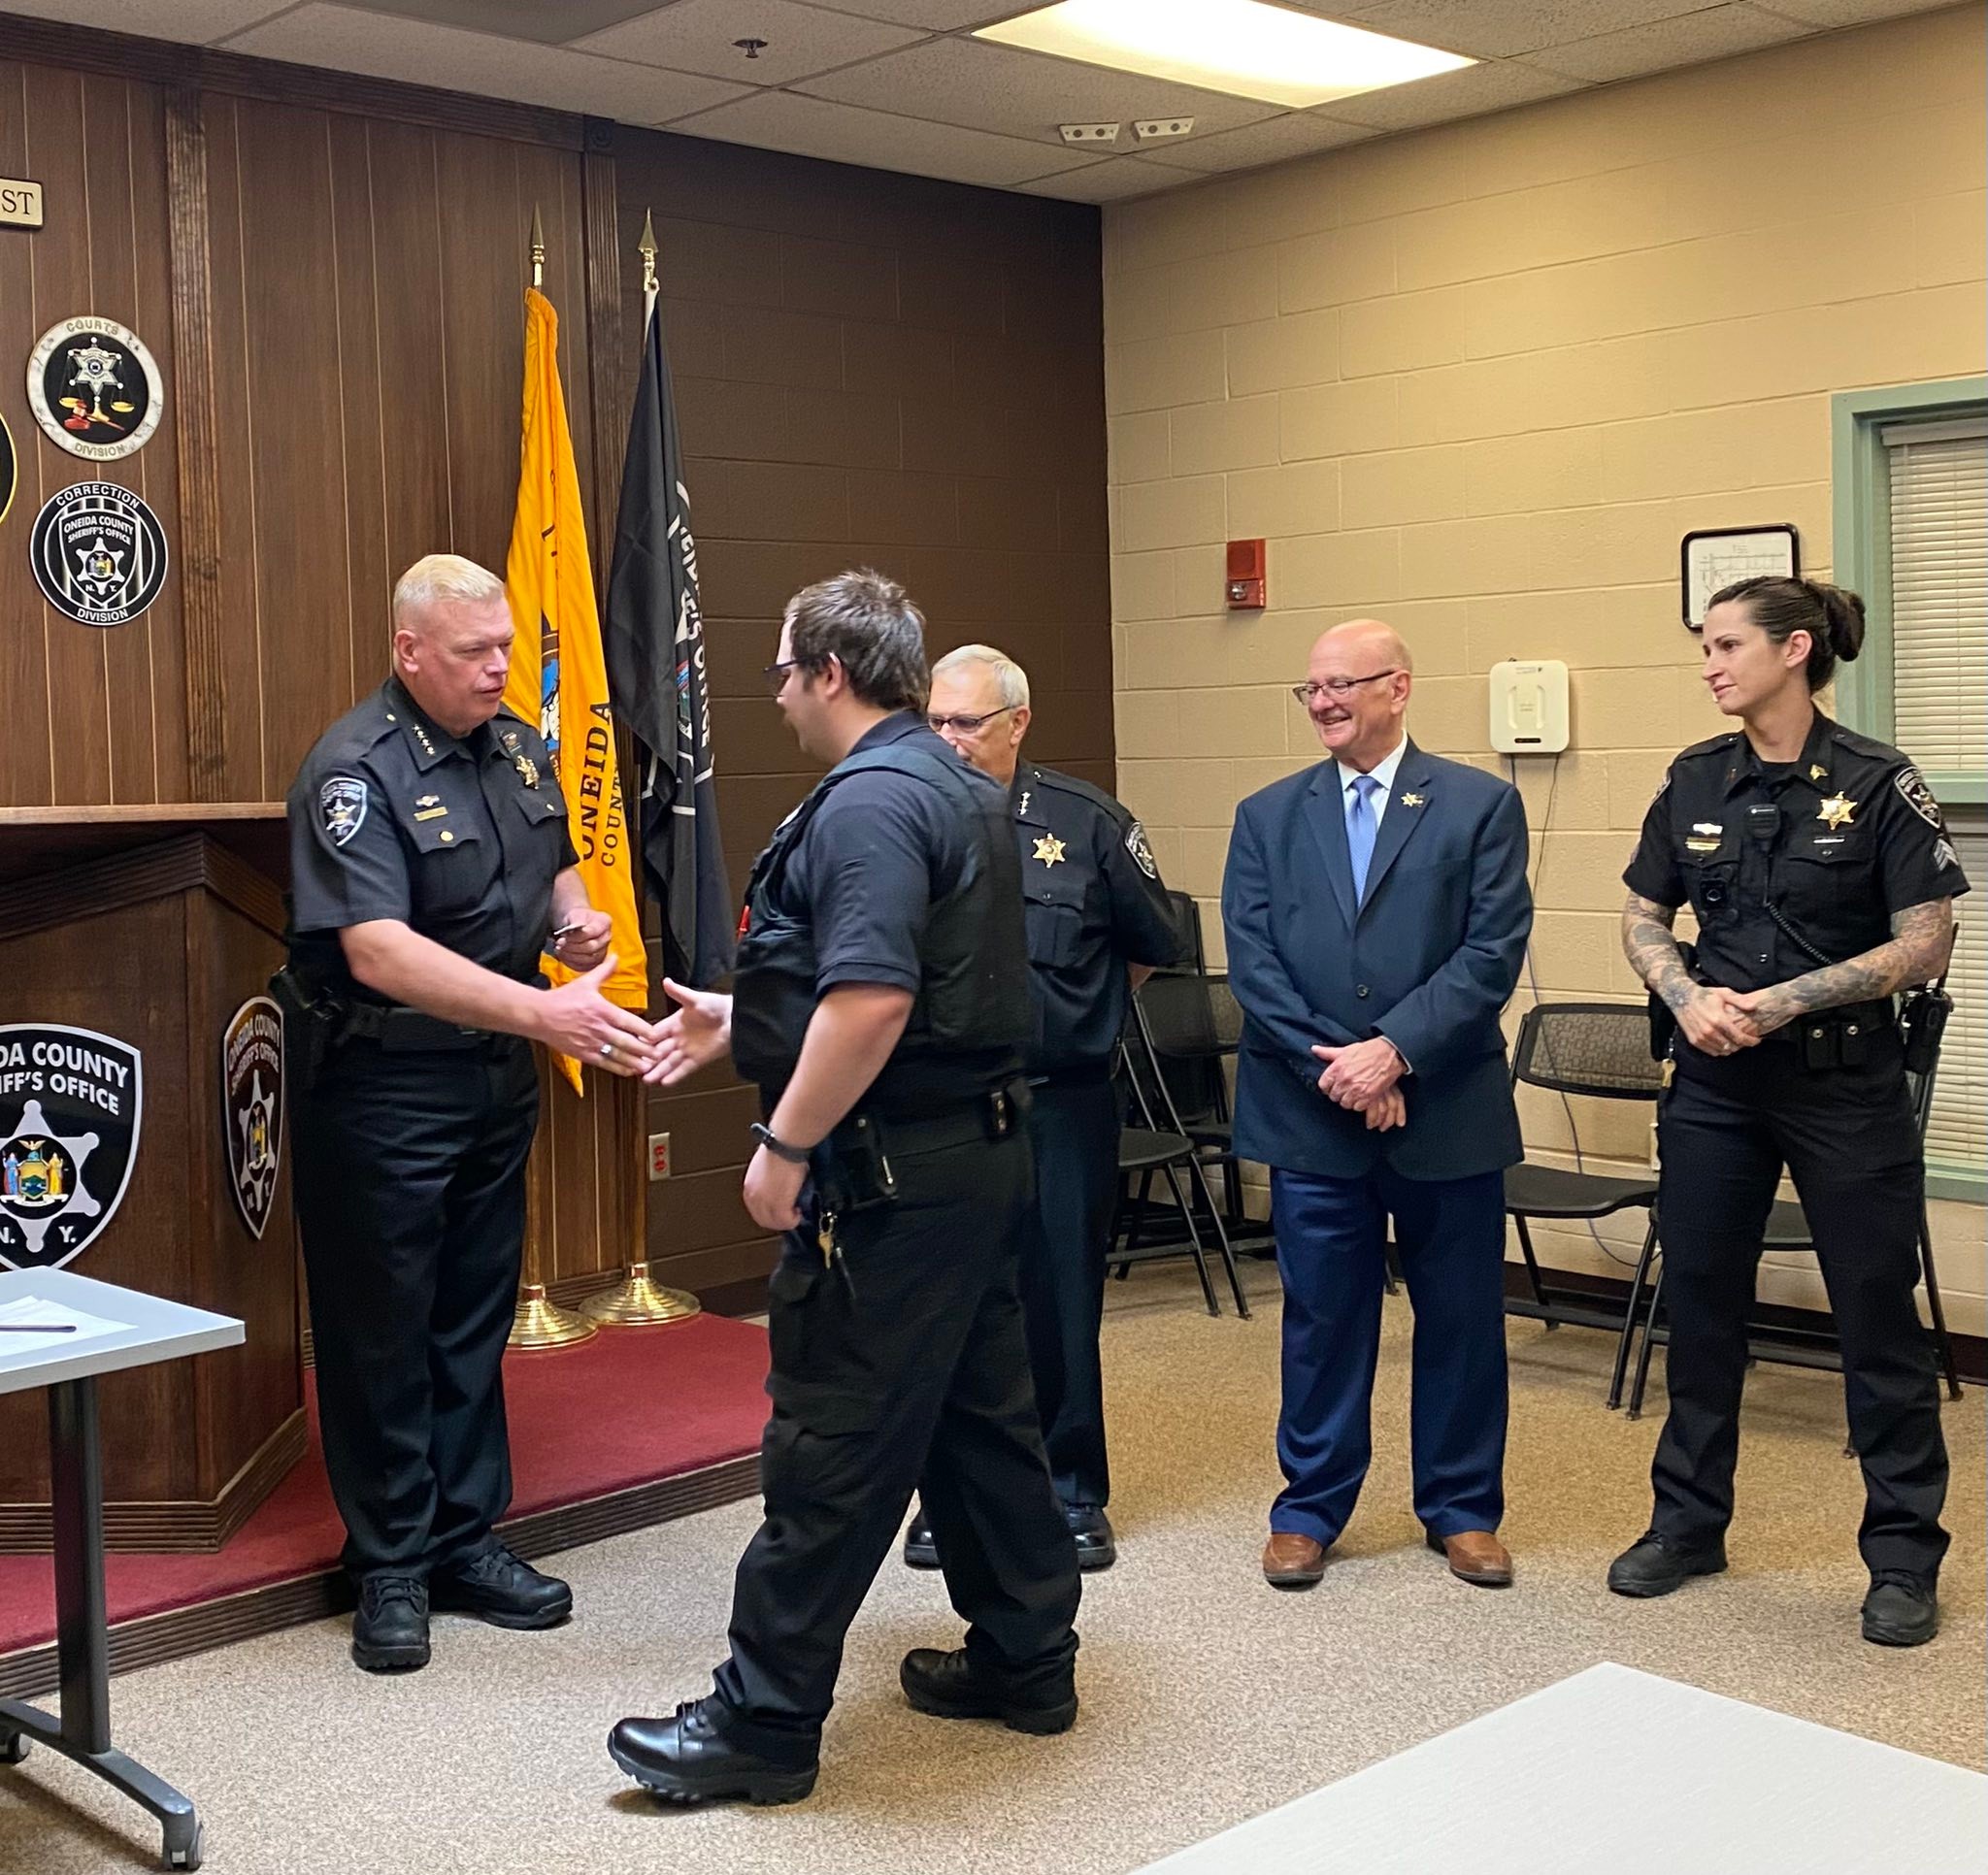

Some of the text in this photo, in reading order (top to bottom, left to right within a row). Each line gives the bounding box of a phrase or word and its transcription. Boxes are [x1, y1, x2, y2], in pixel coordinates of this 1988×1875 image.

[2, 189, 34, 215] ST
[66, 319, 119, 336] COURTS
[75, 443, 126, 457] DIVISION
[55, 484, 140, 510] CORRECTION
[63, 515, 134, 536] ONEIDA COUNTY
[67, 527, 131, 545] SHERIFF'S OFFICE
[77, 609, 129, 622] DIVISION
[31, 1041, 129, 1088] COUNTY
[49, 1072, 119, 1115] OFFICE
[58, 1226, 77, 1243] Y.
